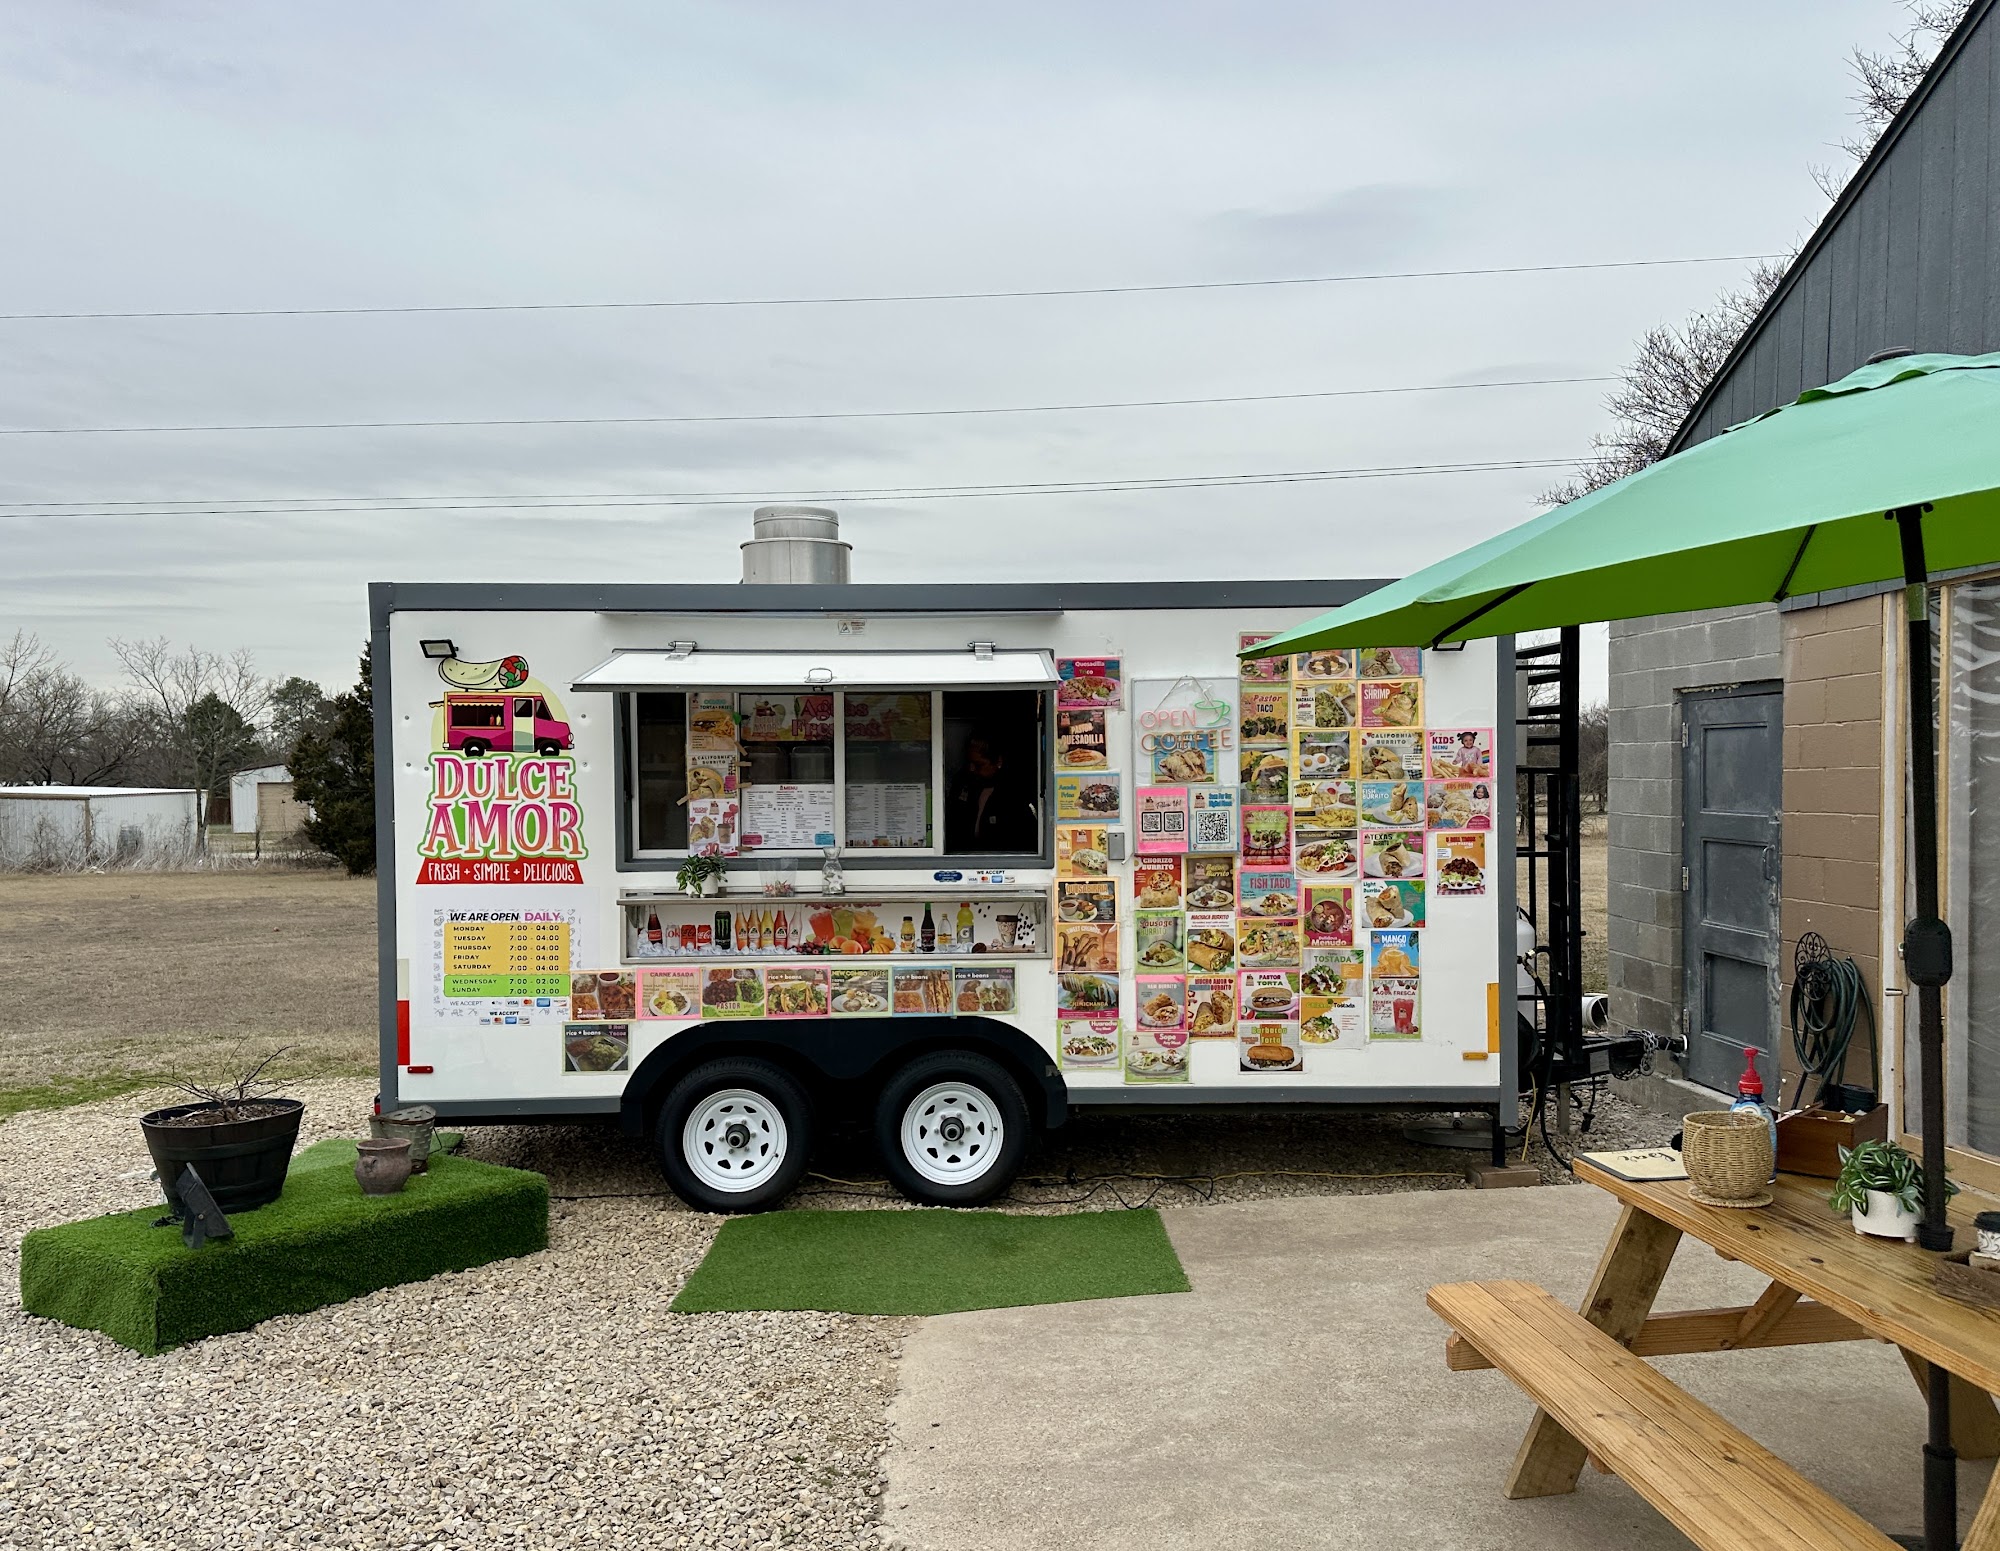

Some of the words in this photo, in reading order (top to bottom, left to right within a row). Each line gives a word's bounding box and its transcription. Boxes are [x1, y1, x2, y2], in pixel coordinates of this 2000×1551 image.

[1253, 694, 1282, 702] Pastor
[1363, 688, 1391, 700] SHRIMP
[1256, 704, 1274, 713] TACO
[1140, 709, 1197, 729] OPEN
[1062, 733, 1104, 745] QUESADILLA
[1141, 728, 1233, 751] COFFEE
[1432, 736, 1454, 744] KIDS
[434, 757, 573, 801] DULCE
[422, 800, 584, 857] AMOR
[1370, 833, 1393, 841] TEXAS
[428, 862, 460, 881] FRESH
[473, 862, 510, 882] SIMPLE
[523, 862, 575, 882] DELICIOUS
[1250, 878, 1268, 889] FISH
[1270, 877, 1291, 888] TACO
[450, 912, 467, 921] WE
[468, 912, 489, 921] ARE
[490, 912, 519, 921] OPEN
[524, 912, 560, 921] DAILY
[1140, 920, 1173, 928] Sausage
[1381, 934, 1407, 944] MANGO
[1314, 955, 1352, 963] TOSTADA
[715, 1001, 741, 1010] PASTOR
[1159, 1033, 1176, 1041] Sope
